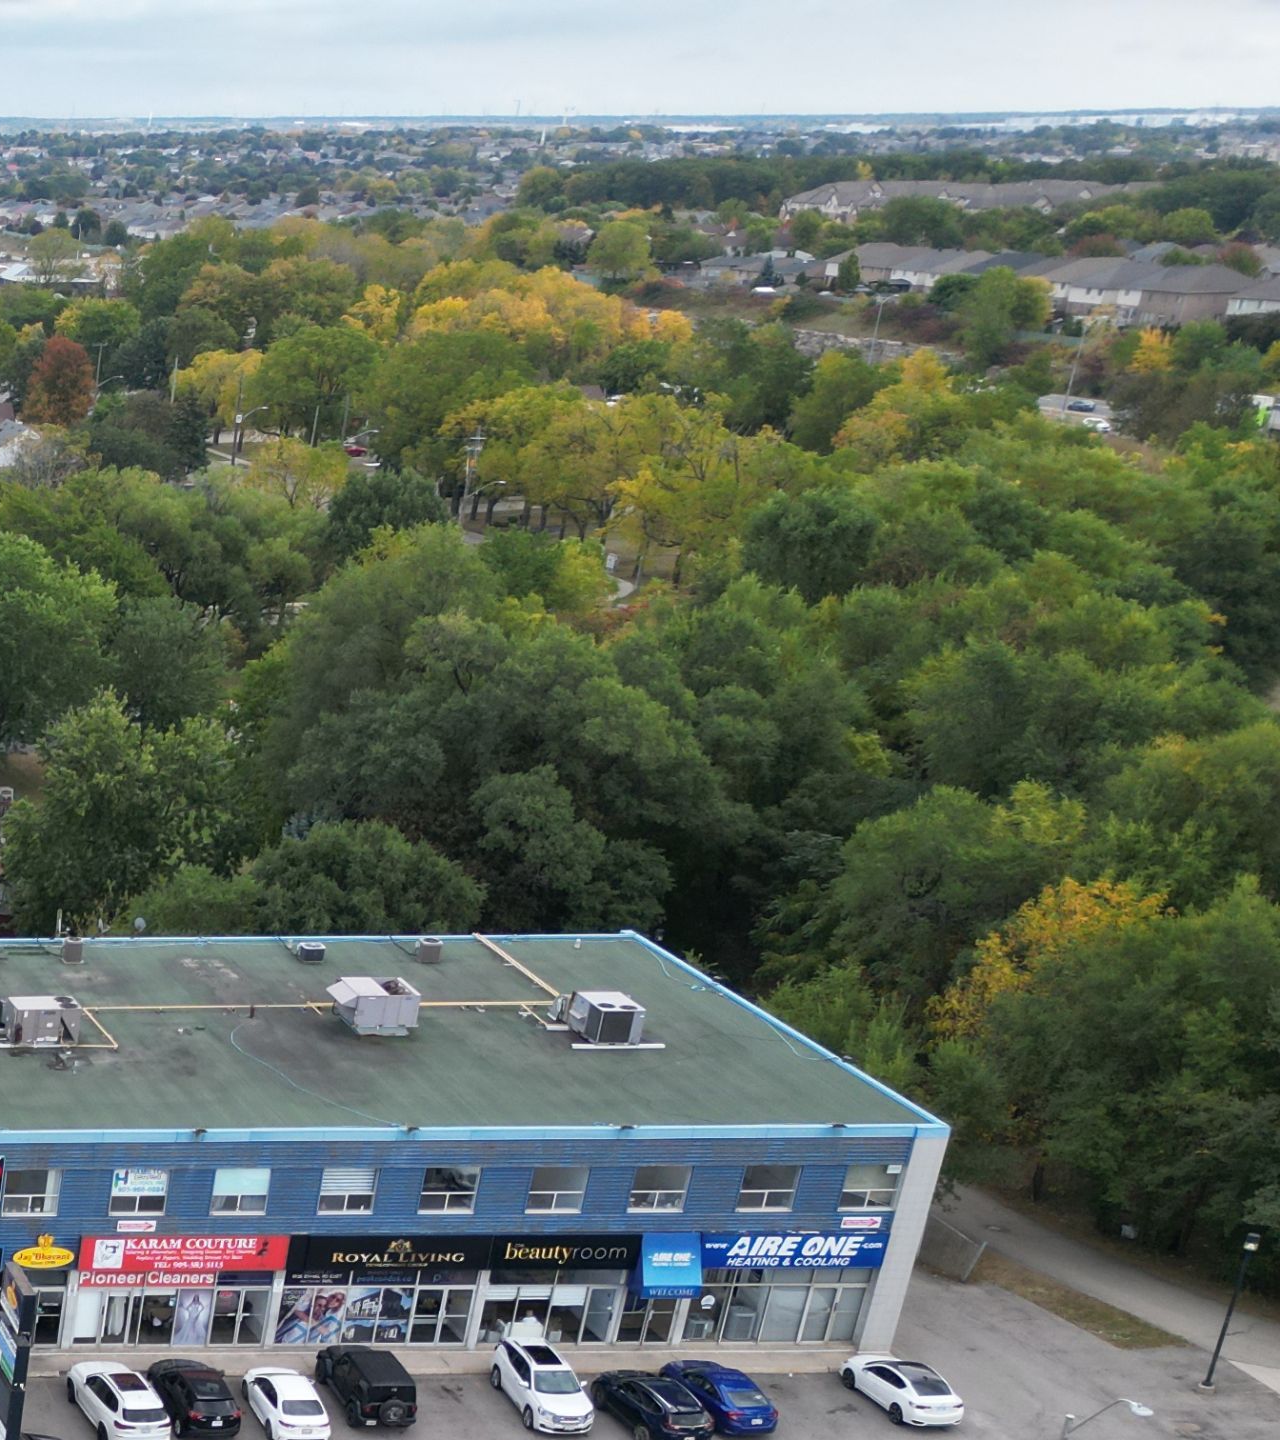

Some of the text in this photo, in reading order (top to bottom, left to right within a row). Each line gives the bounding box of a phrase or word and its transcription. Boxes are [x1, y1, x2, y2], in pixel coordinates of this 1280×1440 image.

[125, 1239, 257, 1249] KARAM COUTURE
[727, 1236, 802, 1256] AIRE
[801, 1236, 865, 1256] ONE
[331, 1252, 465, 1263] ROYAL LIVING
[726, 1257, 851, 1266] HEATING & COOLING
[79, 1271, 215, 1284] Pioneer Cleaners
